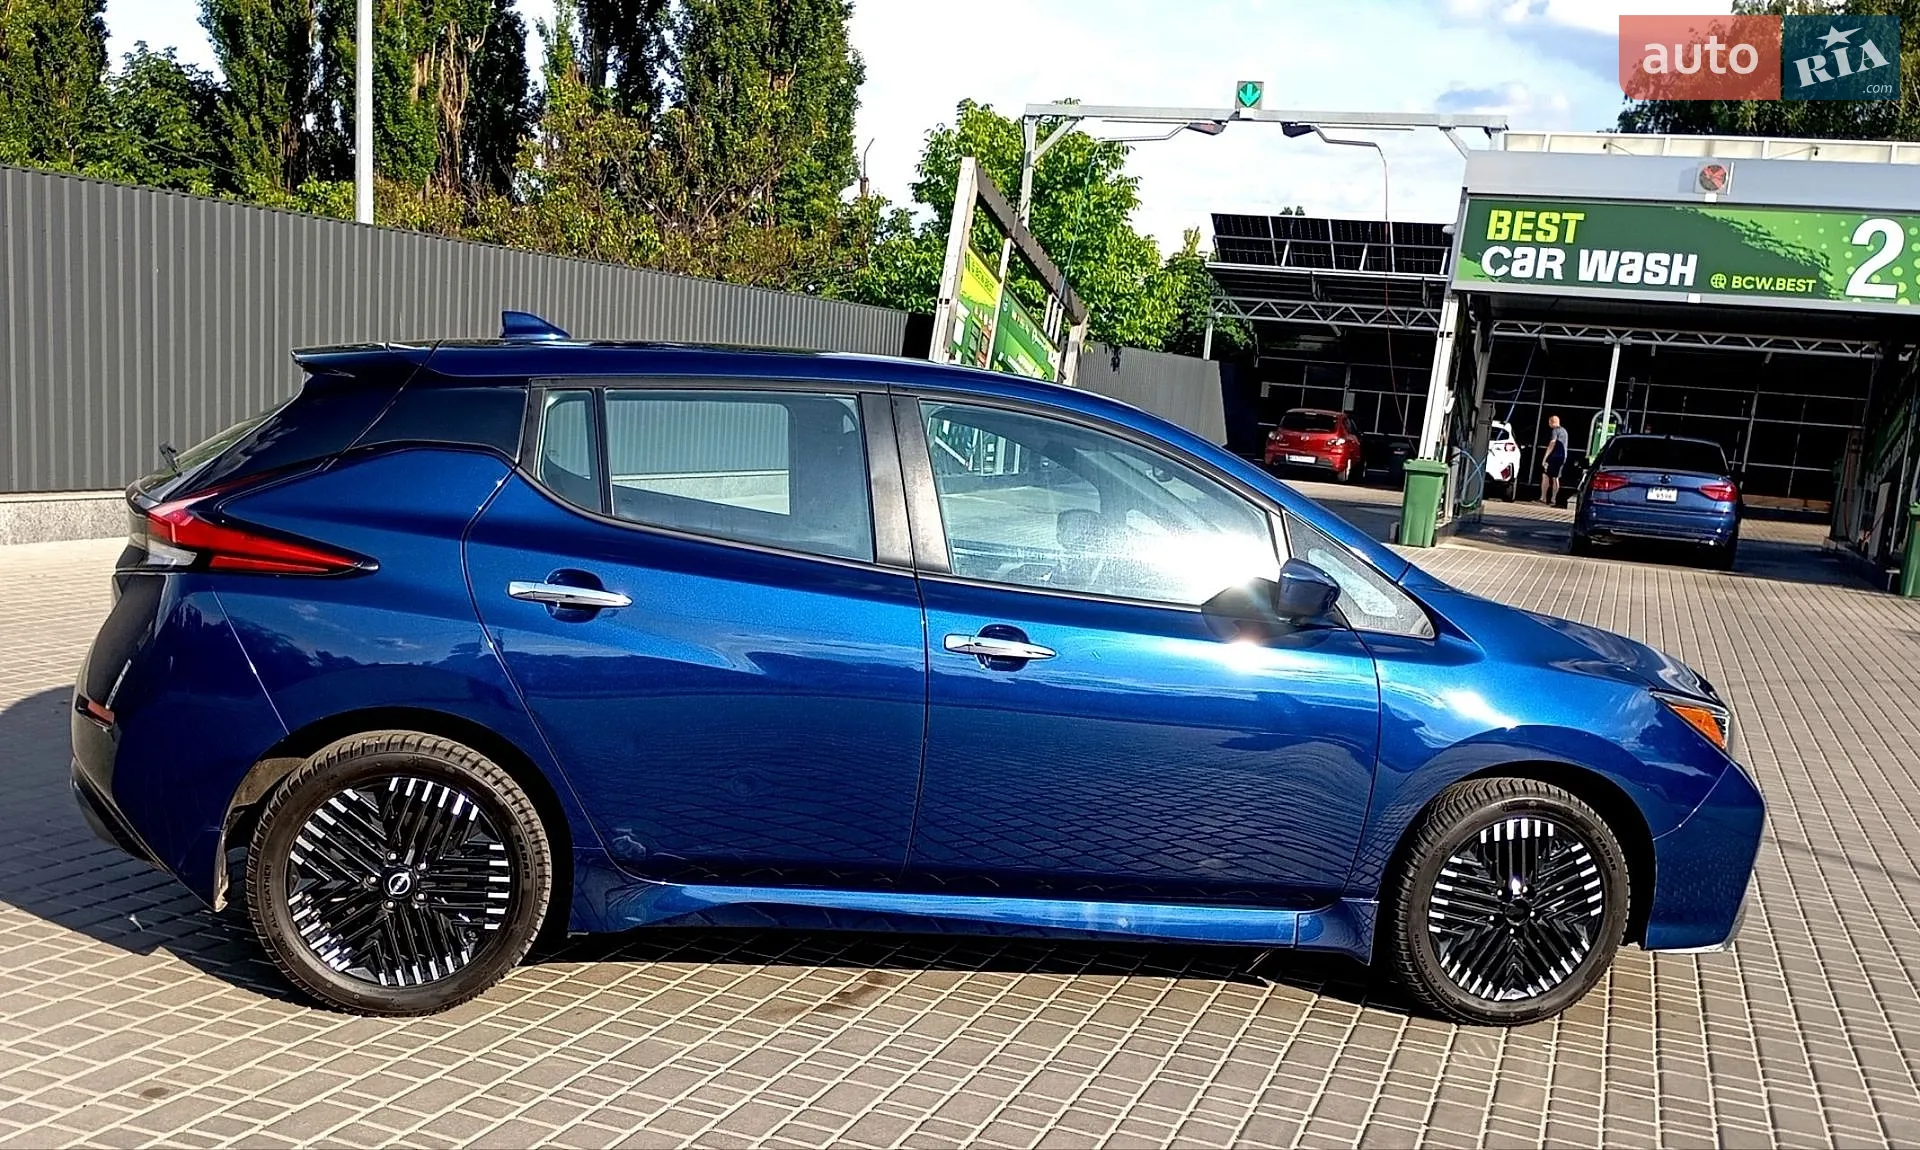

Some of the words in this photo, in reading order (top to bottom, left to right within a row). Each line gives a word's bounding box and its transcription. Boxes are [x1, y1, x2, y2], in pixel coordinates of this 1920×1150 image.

[1486, 209, 1584, 244] BEST
[1844, 217, 1906, 299] 2
[1731, 275, 1817, 294] BCW.BEST
[262, 863, 274, 910] WEATHER
